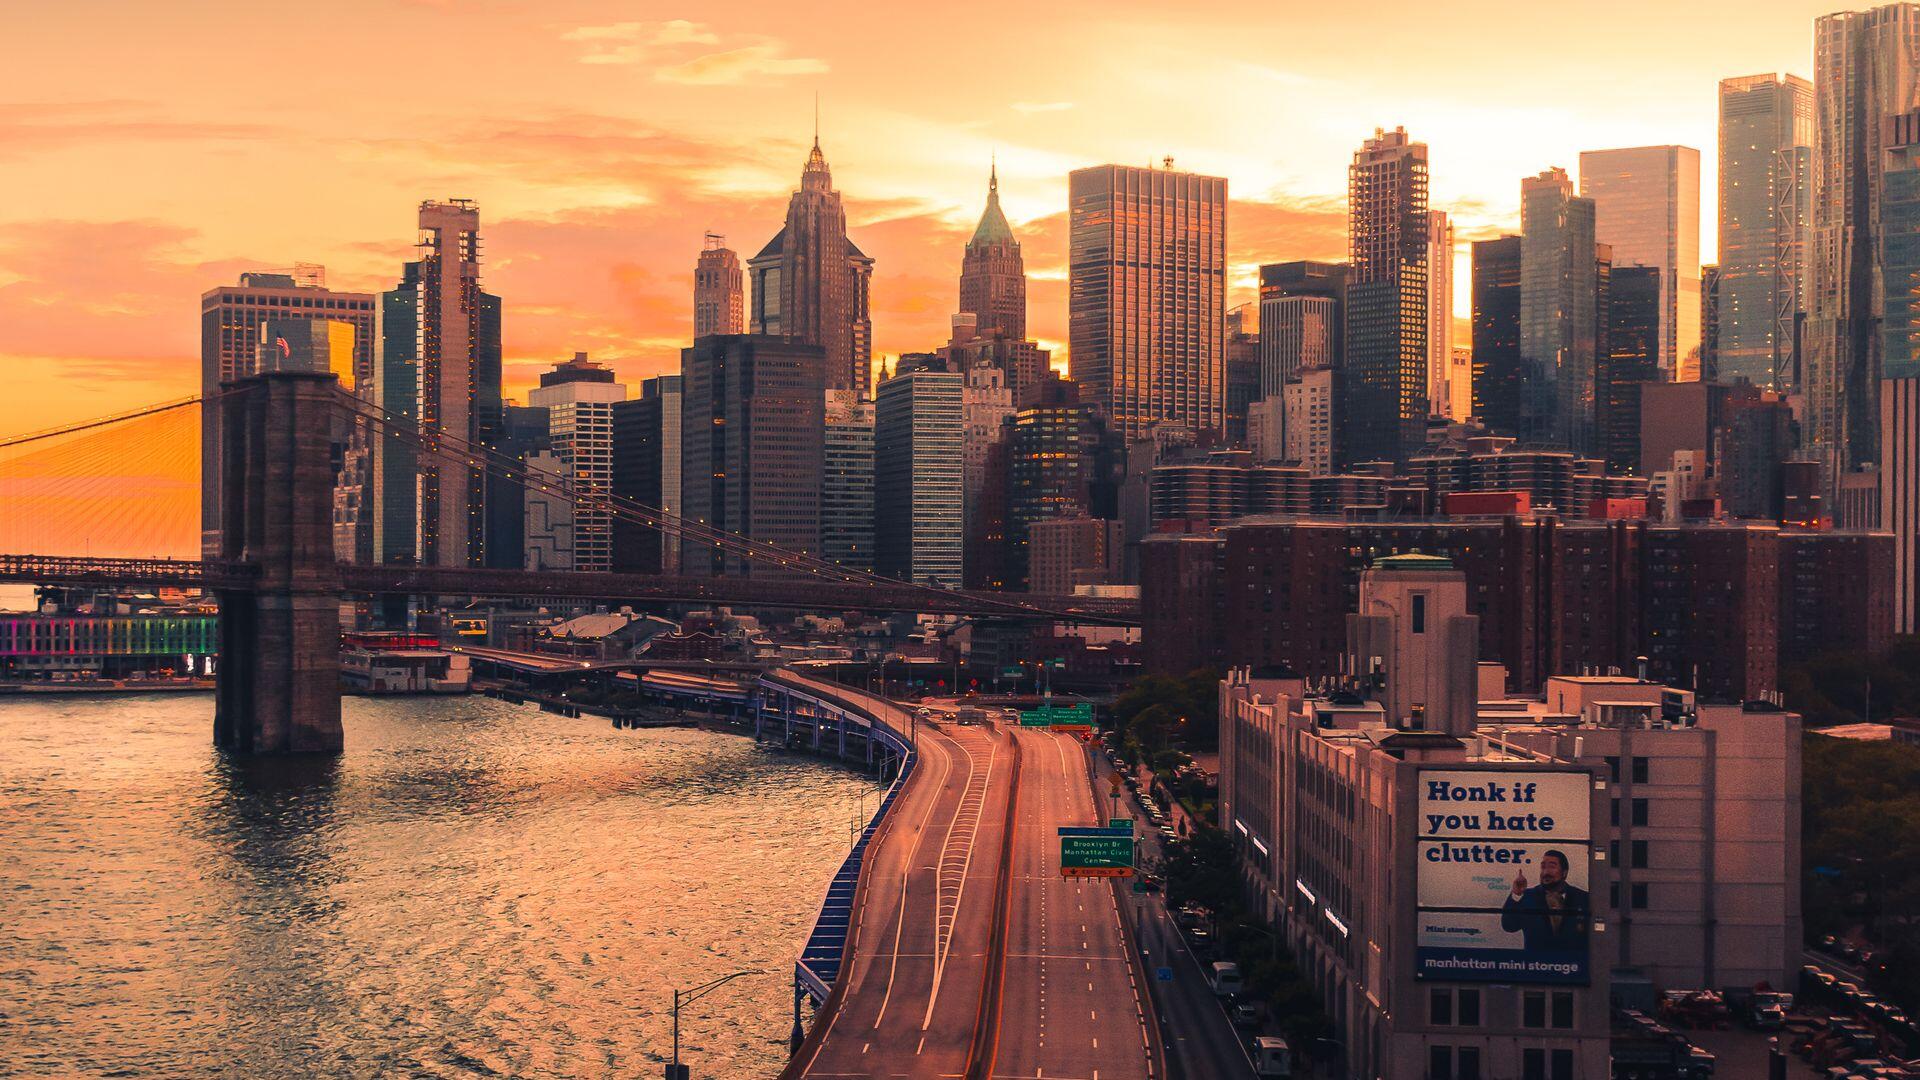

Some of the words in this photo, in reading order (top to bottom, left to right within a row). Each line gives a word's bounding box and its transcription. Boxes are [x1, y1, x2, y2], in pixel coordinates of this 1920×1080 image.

[1427, 781, 1506, 802] Honk
[1513, 782, 1537, 802] if
[1426, 813, 1481, 834] you
[1488, 810, 1554, 831] hate
[1426, 843, 1531, 865] clutter.
[1425, 925, 1446, 933] Mini
[1425, 955, 1496, 969] manhattan
[1498, 959, 1526, 971] mini
[1528, 962, 1579, 975] storage
